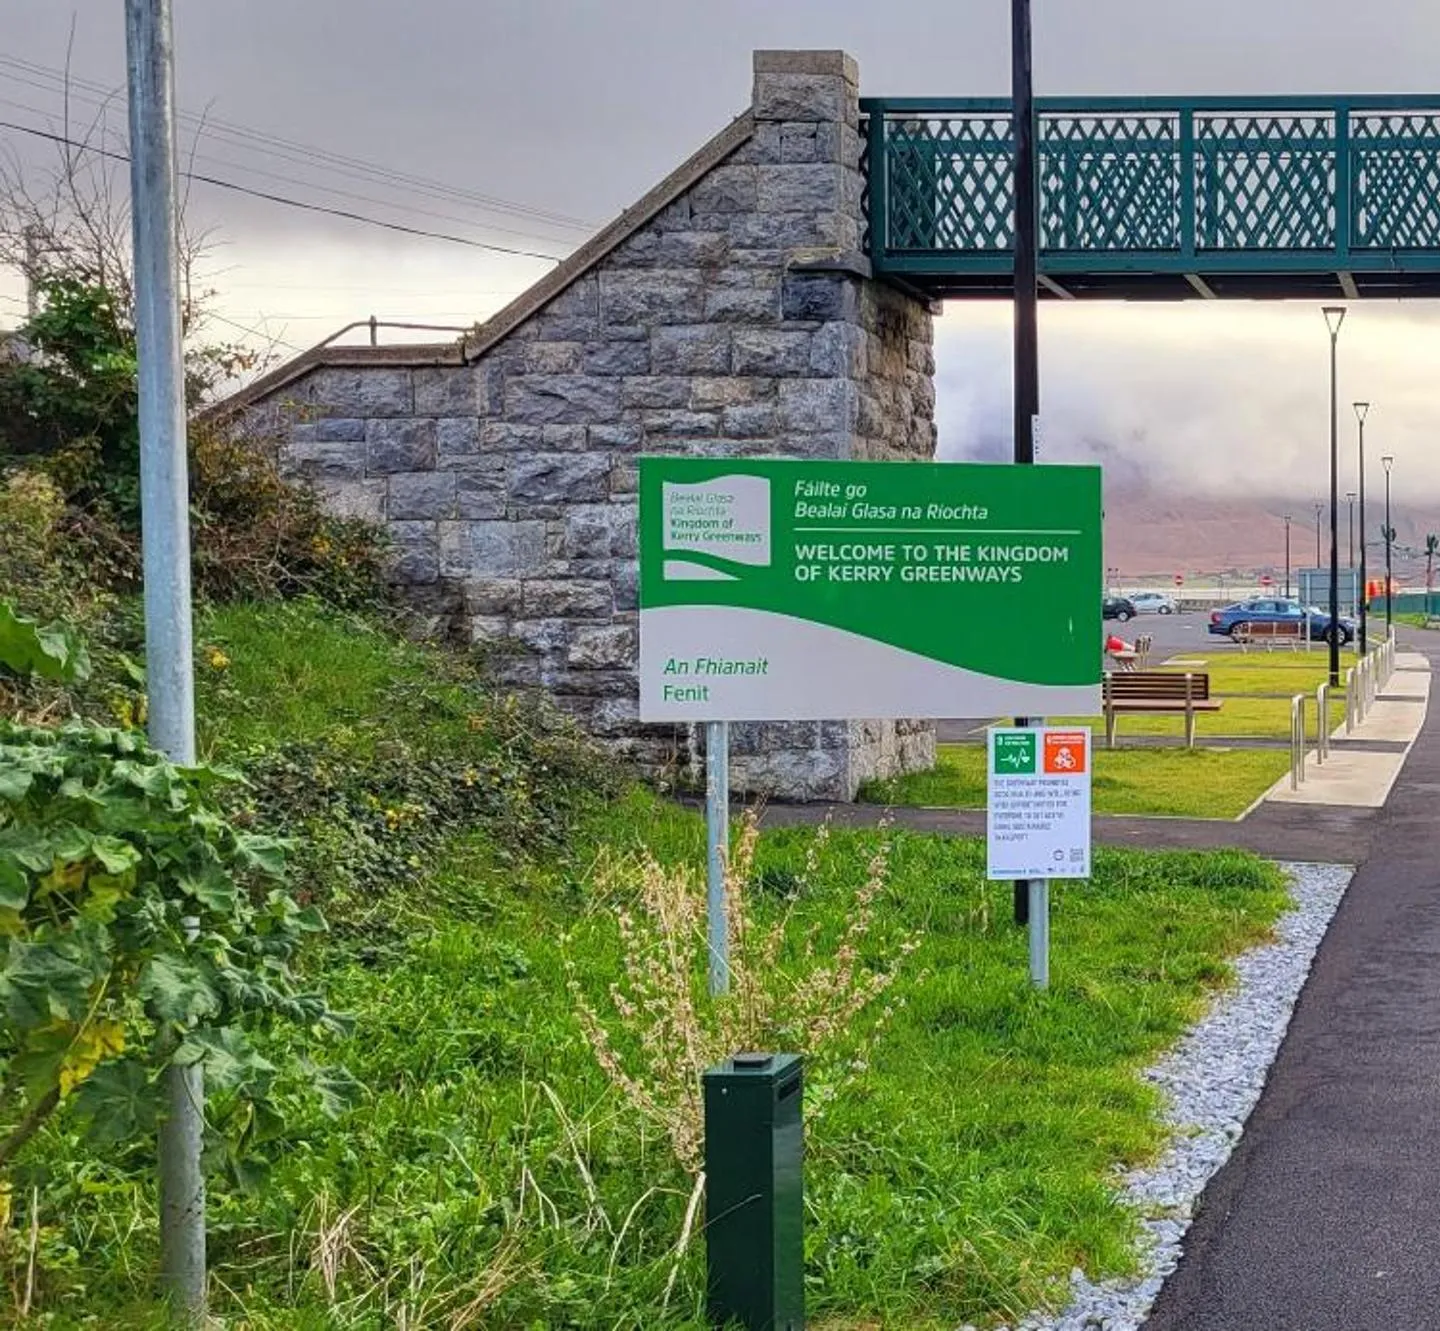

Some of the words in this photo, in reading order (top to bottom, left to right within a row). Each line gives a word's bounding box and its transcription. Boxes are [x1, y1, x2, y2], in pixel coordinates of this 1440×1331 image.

[846, 484, 867, 500] go
[852, 502, 896, 519] Glasa
[901, 506, 922, 519] na
[722, 518, 734, 528] of
[795, 545, 896, 561] WELCOME
[902, 545, 928, 561] TO
[934, 545, 972, 562] THE
[977, 546, 1069, 562] KINGDOM
[794, 565, 822, 581] OF
[828, 565, 894, 581] KERRY
[901, 566, 1023, 582] GREENWAYS
[663, 658, 689, 674] An
[695, 657, 769, 675] Fhianait
[663, 684, 710, 702] Fenit
